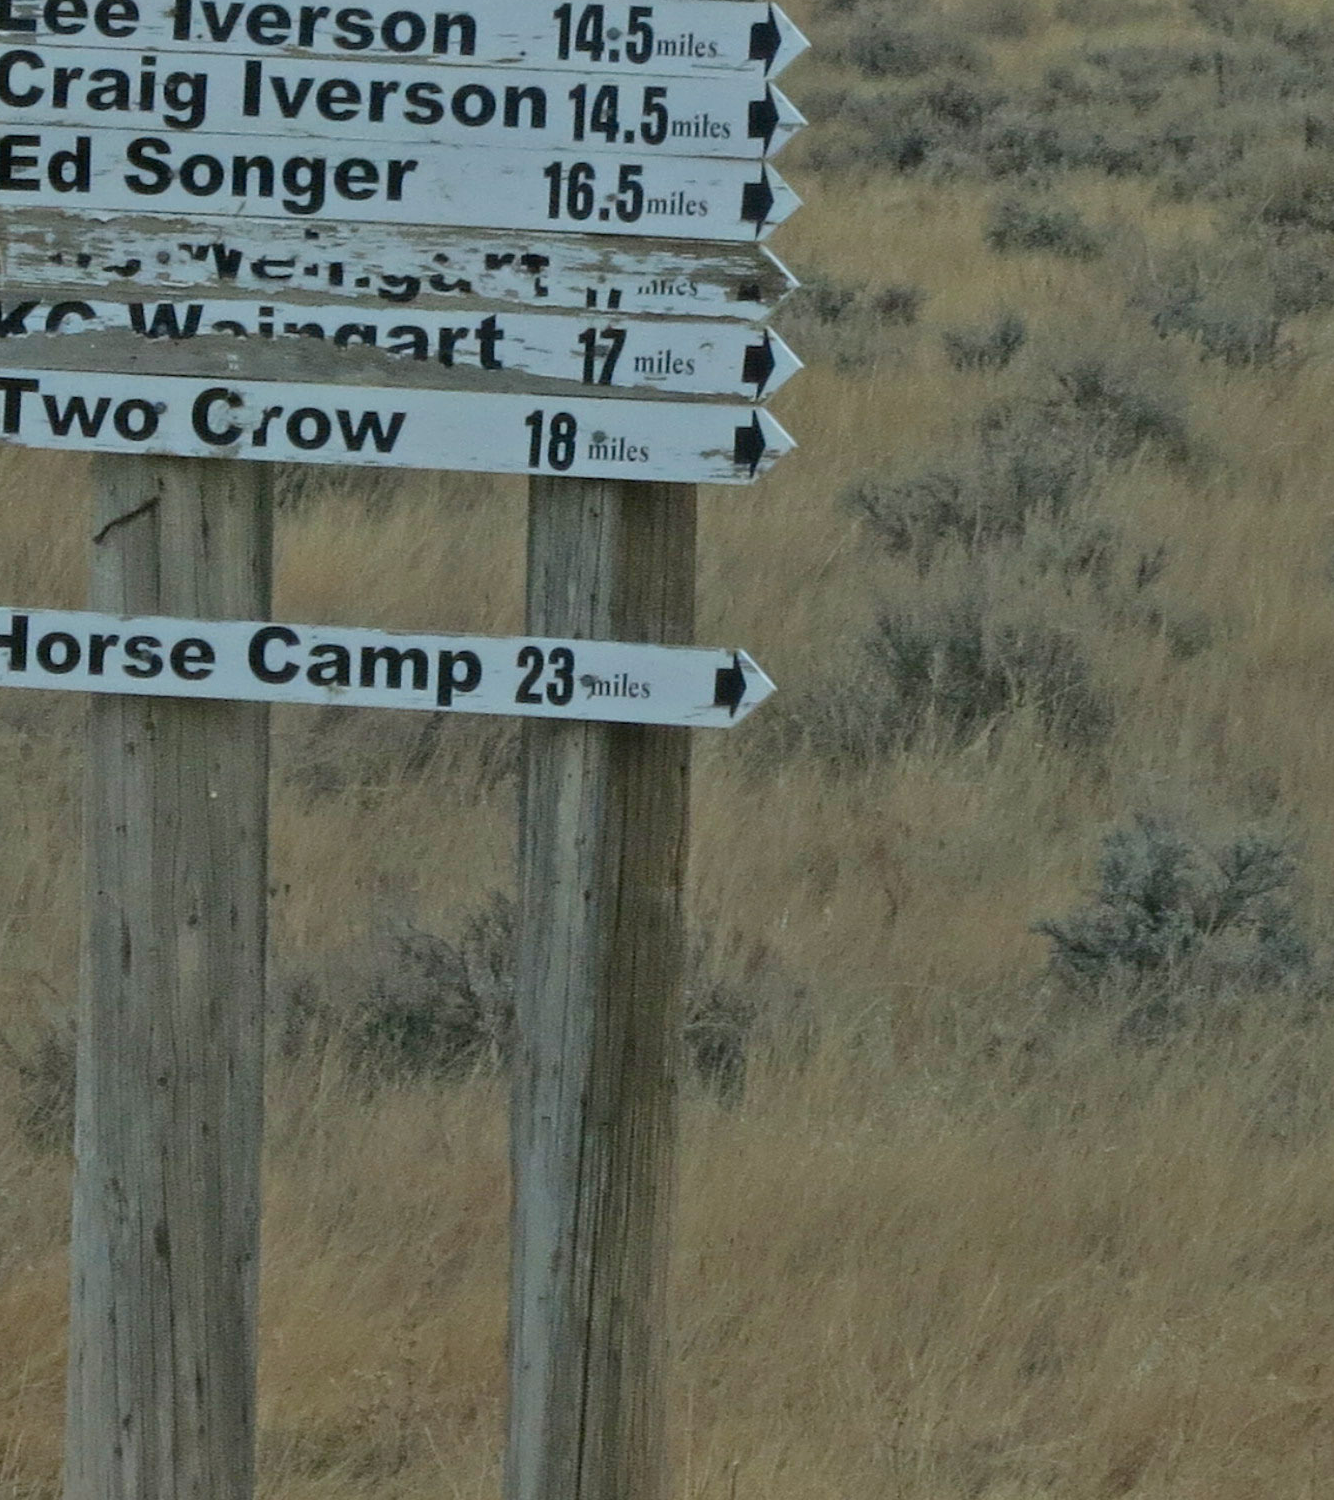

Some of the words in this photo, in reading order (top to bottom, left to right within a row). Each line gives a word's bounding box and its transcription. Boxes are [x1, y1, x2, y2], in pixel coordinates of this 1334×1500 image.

[553, 2, 654, 65] 14.5
[655, 34, 719, 60] miles
[242, 59, 549, 130] Iverson
[568, 83, 670, 146] 14.5
[670, 112, 731, 139] miles
[123, 136, 419, 216] Songer
[543, 161, 645, 224] 16.5
[646, 193, 709, 217] miles
[128, 302, 505, 370] Wiart
[577, 327, 628, 386] 17
[634, 350, 696, 376] miles
[192, 387, 407, 453] Crow
[524, 409, 578, 472] 18
[587, 436, 651, 463] miles
[248, 624, 484, 707] Camp
[514, 645, 576, 706] 23
[589, 673, 652, 699] miles
